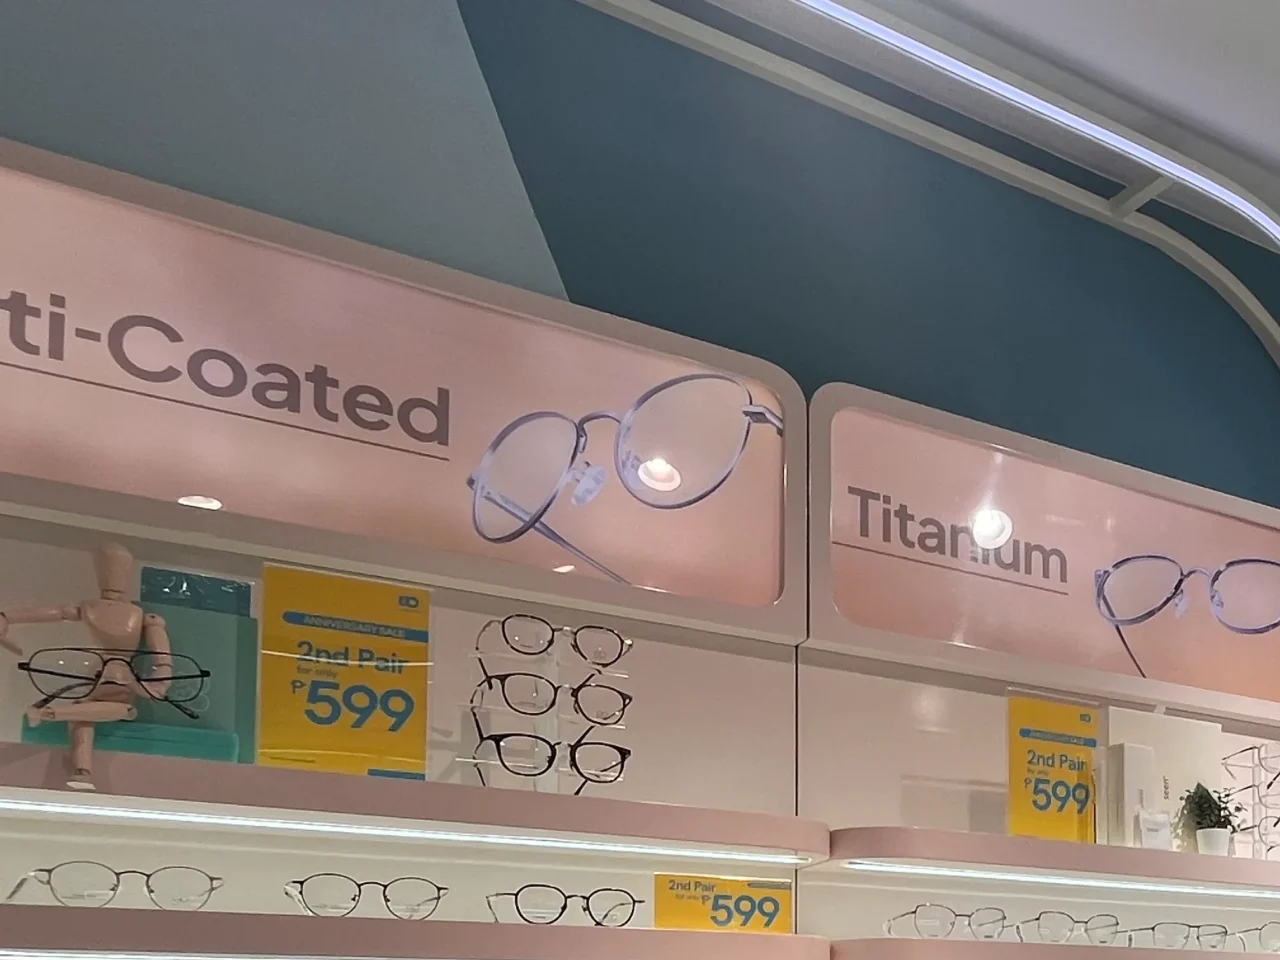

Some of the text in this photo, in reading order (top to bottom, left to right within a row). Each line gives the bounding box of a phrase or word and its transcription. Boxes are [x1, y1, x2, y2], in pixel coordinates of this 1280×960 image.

[297, 641, 409, 674] 2nd Pair
[1027, 750, 1056, 768] 2nd
[1059, 754, 1087, 772] Pair
[668, 879, 716, 893] 2nd Pair
